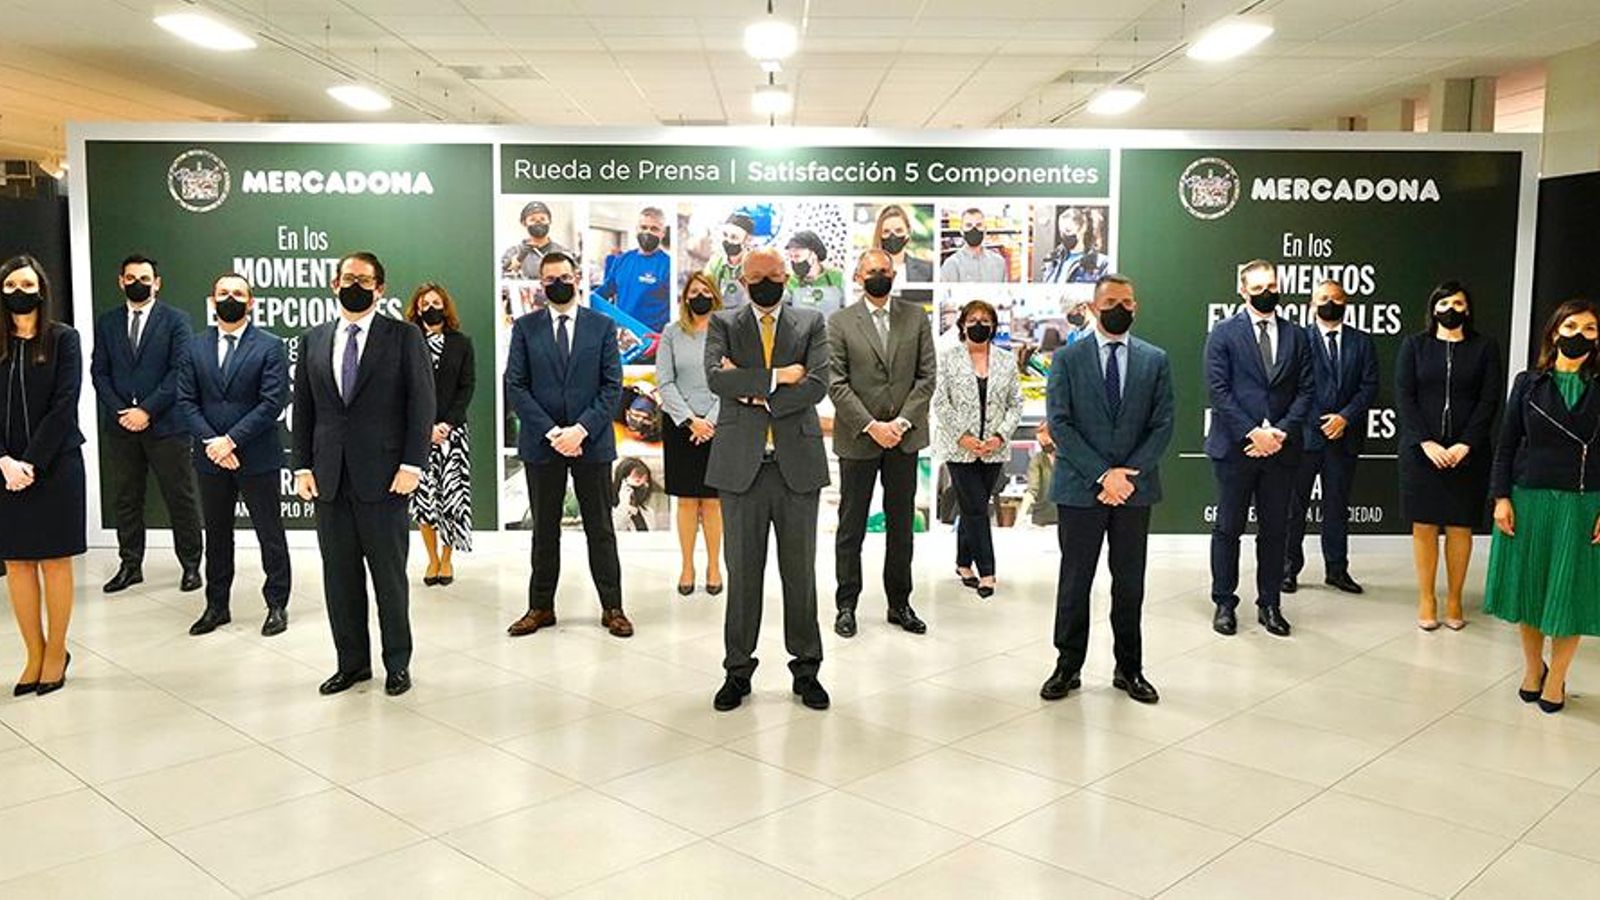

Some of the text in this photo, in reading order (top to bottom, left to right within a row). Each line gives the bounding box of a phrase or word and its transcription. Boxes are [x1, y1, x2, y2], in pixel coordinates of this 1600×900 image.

[241, 170, 434, 194] MERCADONA
[514, 159, 720, 181] Rueda de Prensa
[747, 160, 1099, 186] Satisfacción 5 Componentes
[1250, 177, 1440, 202] MERCADONA
[278, 225, 328, 251] En los
[1282, 232, 1333, 258] En los
[233, 257, 341, 289] MOMENT
[1236, 263, 1376, 296] MENTOS
